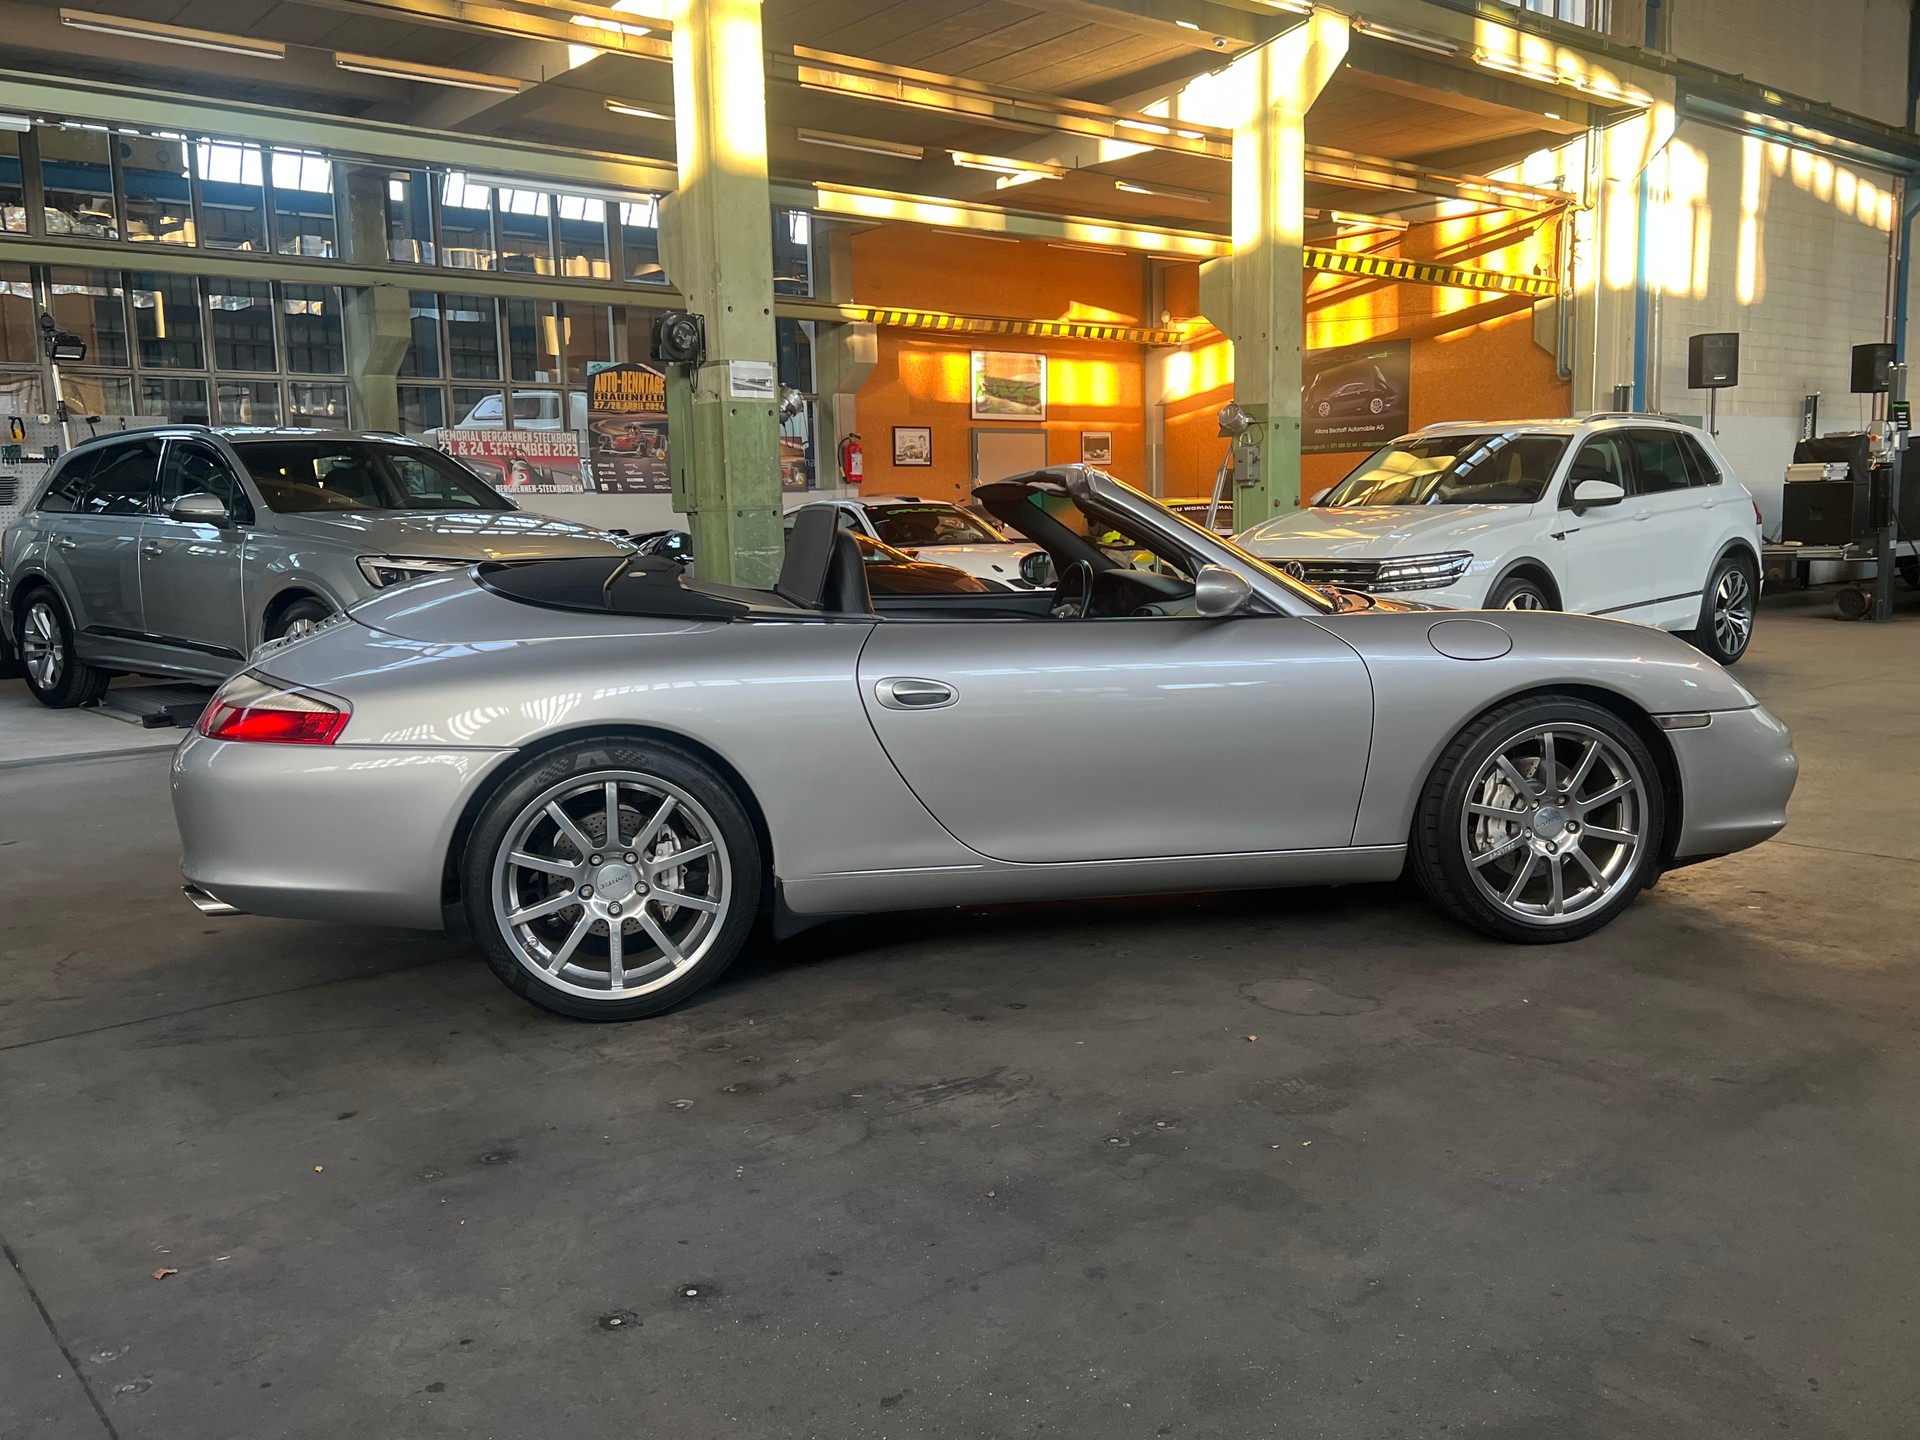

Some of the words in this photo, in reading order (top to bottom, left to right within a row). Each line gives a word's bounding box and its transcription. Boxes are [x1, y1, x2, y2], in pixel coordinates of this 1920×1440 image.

[594, 371, 665, 394] AUTO-RENNTAGE
[594, 393, 664, 402] FRAUENFELD
[645, 402, 665, 411] 2024
[1348, 425, 1376, 433] Automobile
[437, 430, 480, 442] MEMORIAL
[481, 431, 533, 443] BERGRENNEN
[534, 432, 578, 444] STECKBORN
[459, 442, 468, 455] &
[470, 442, 489, 456] 24.
[553, 443, 579, 457] 2023
